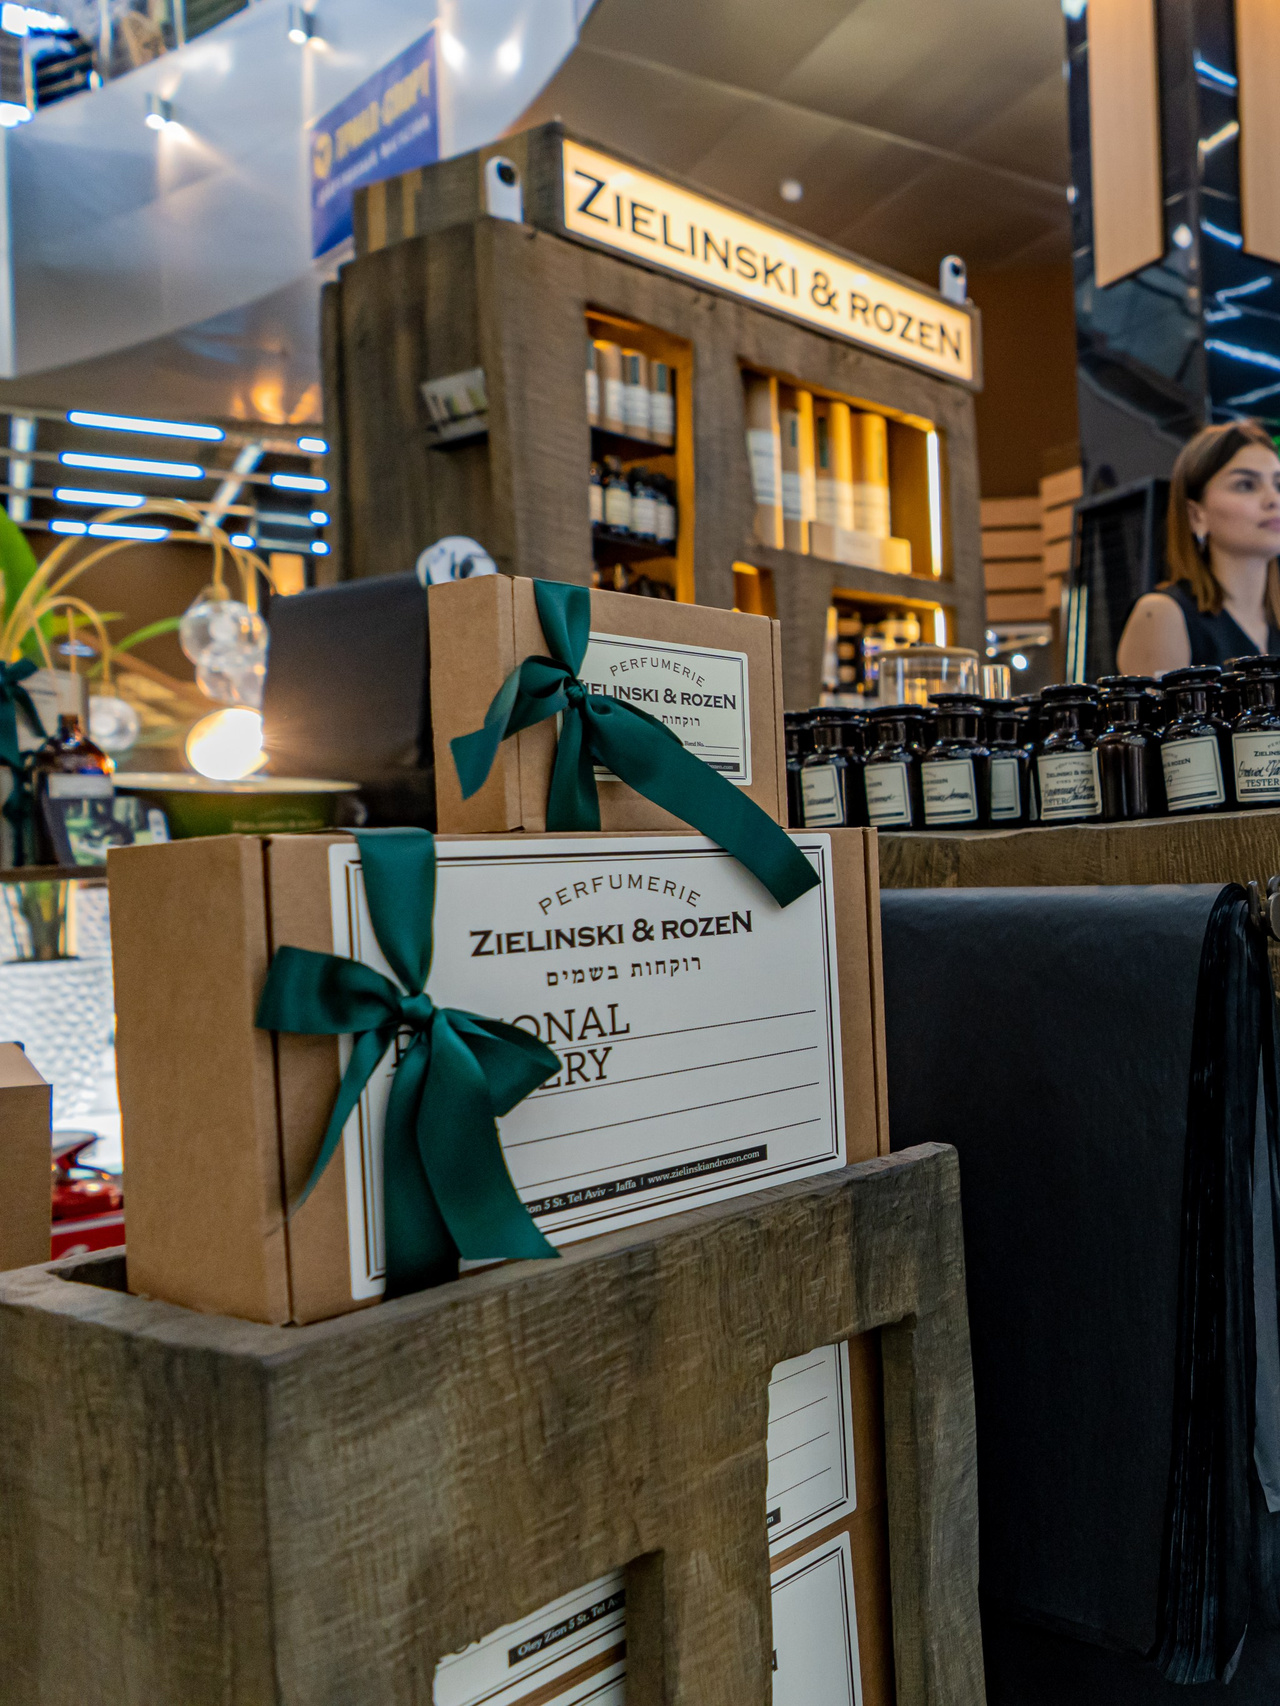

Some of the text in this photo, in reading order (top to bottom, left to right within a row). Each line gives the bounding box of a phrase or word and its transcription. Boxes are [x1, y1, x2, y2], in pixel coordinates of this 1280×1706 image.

[574, 170, 963, 361] ZIELINSKI & ROZEN
[609, 657, 706, 688] PERFUMERIE
[578, 679, 736, 710] IELINSKI & ROZEN
[1246, 778, 1280, 788] TESTER
[538, 874, 701, 916] PERFUMERIE
[470, 910, 753, 957] ZIELINSKI & ROZEN
[546, 956, 702, 988] רוקחות בשמים
[544, 1199, 551, 1210] 5
[553, 1197, 566, 1208] St.
[568, 1193, 583, 1204] Tel
[585, 1188, 606, 1199] Aviv
[616, 1179, 637, 1193] Jaffa
[648, 1150, 760, 1185] www.zielinskiandrozen.com
[544, 1625, 567, 1643] Zion
